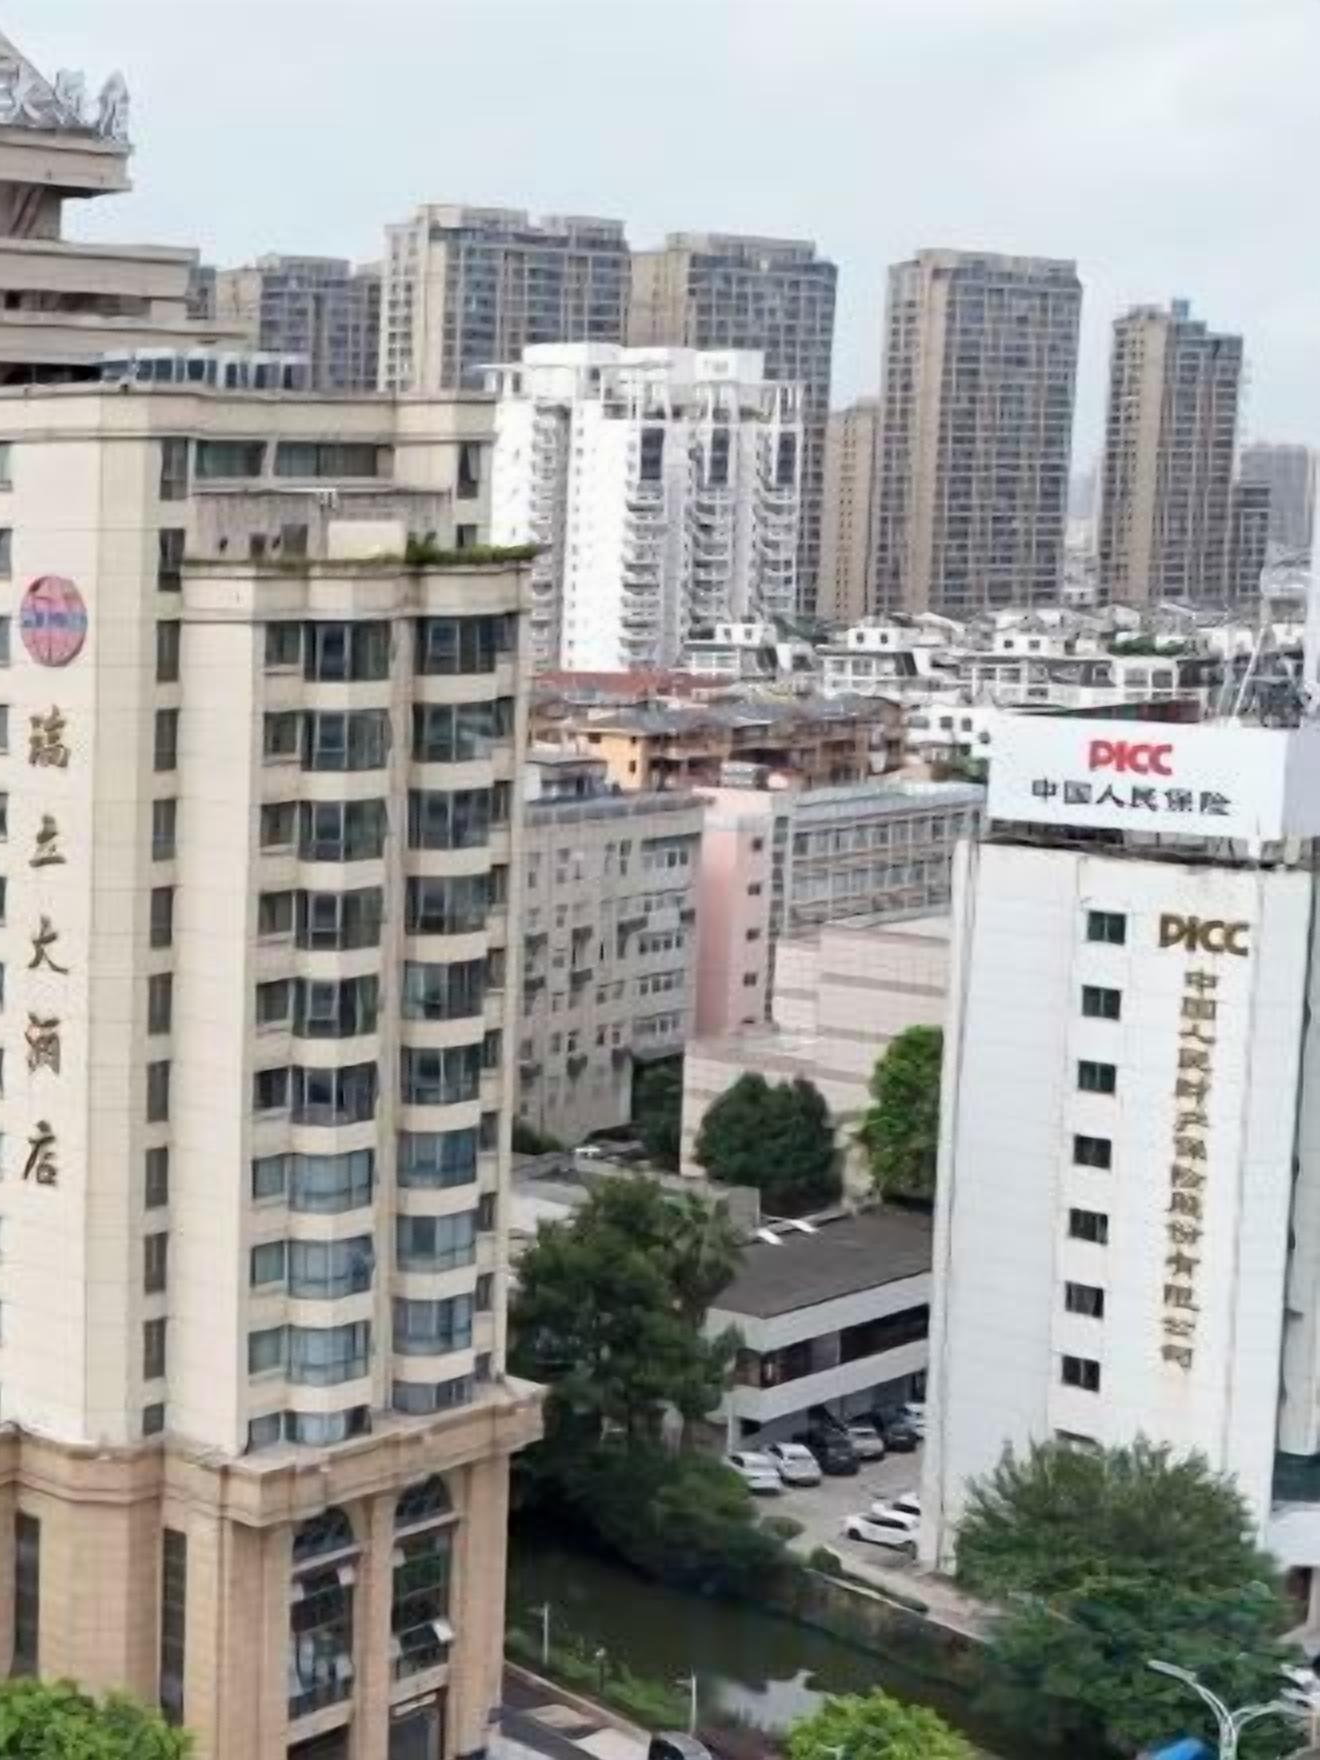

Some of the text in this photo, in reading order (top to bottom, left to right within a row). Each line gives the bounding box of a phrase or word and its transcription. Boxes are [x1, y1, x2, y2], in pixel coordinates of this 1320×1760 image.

[1088, 740, 1173, 776] PICC
[1031, 776, 1233, 816] 中国人民保险
[22, 703, 71, 1186] 瑞立大酒店
[1159, 912, 1250, 957] PICC
